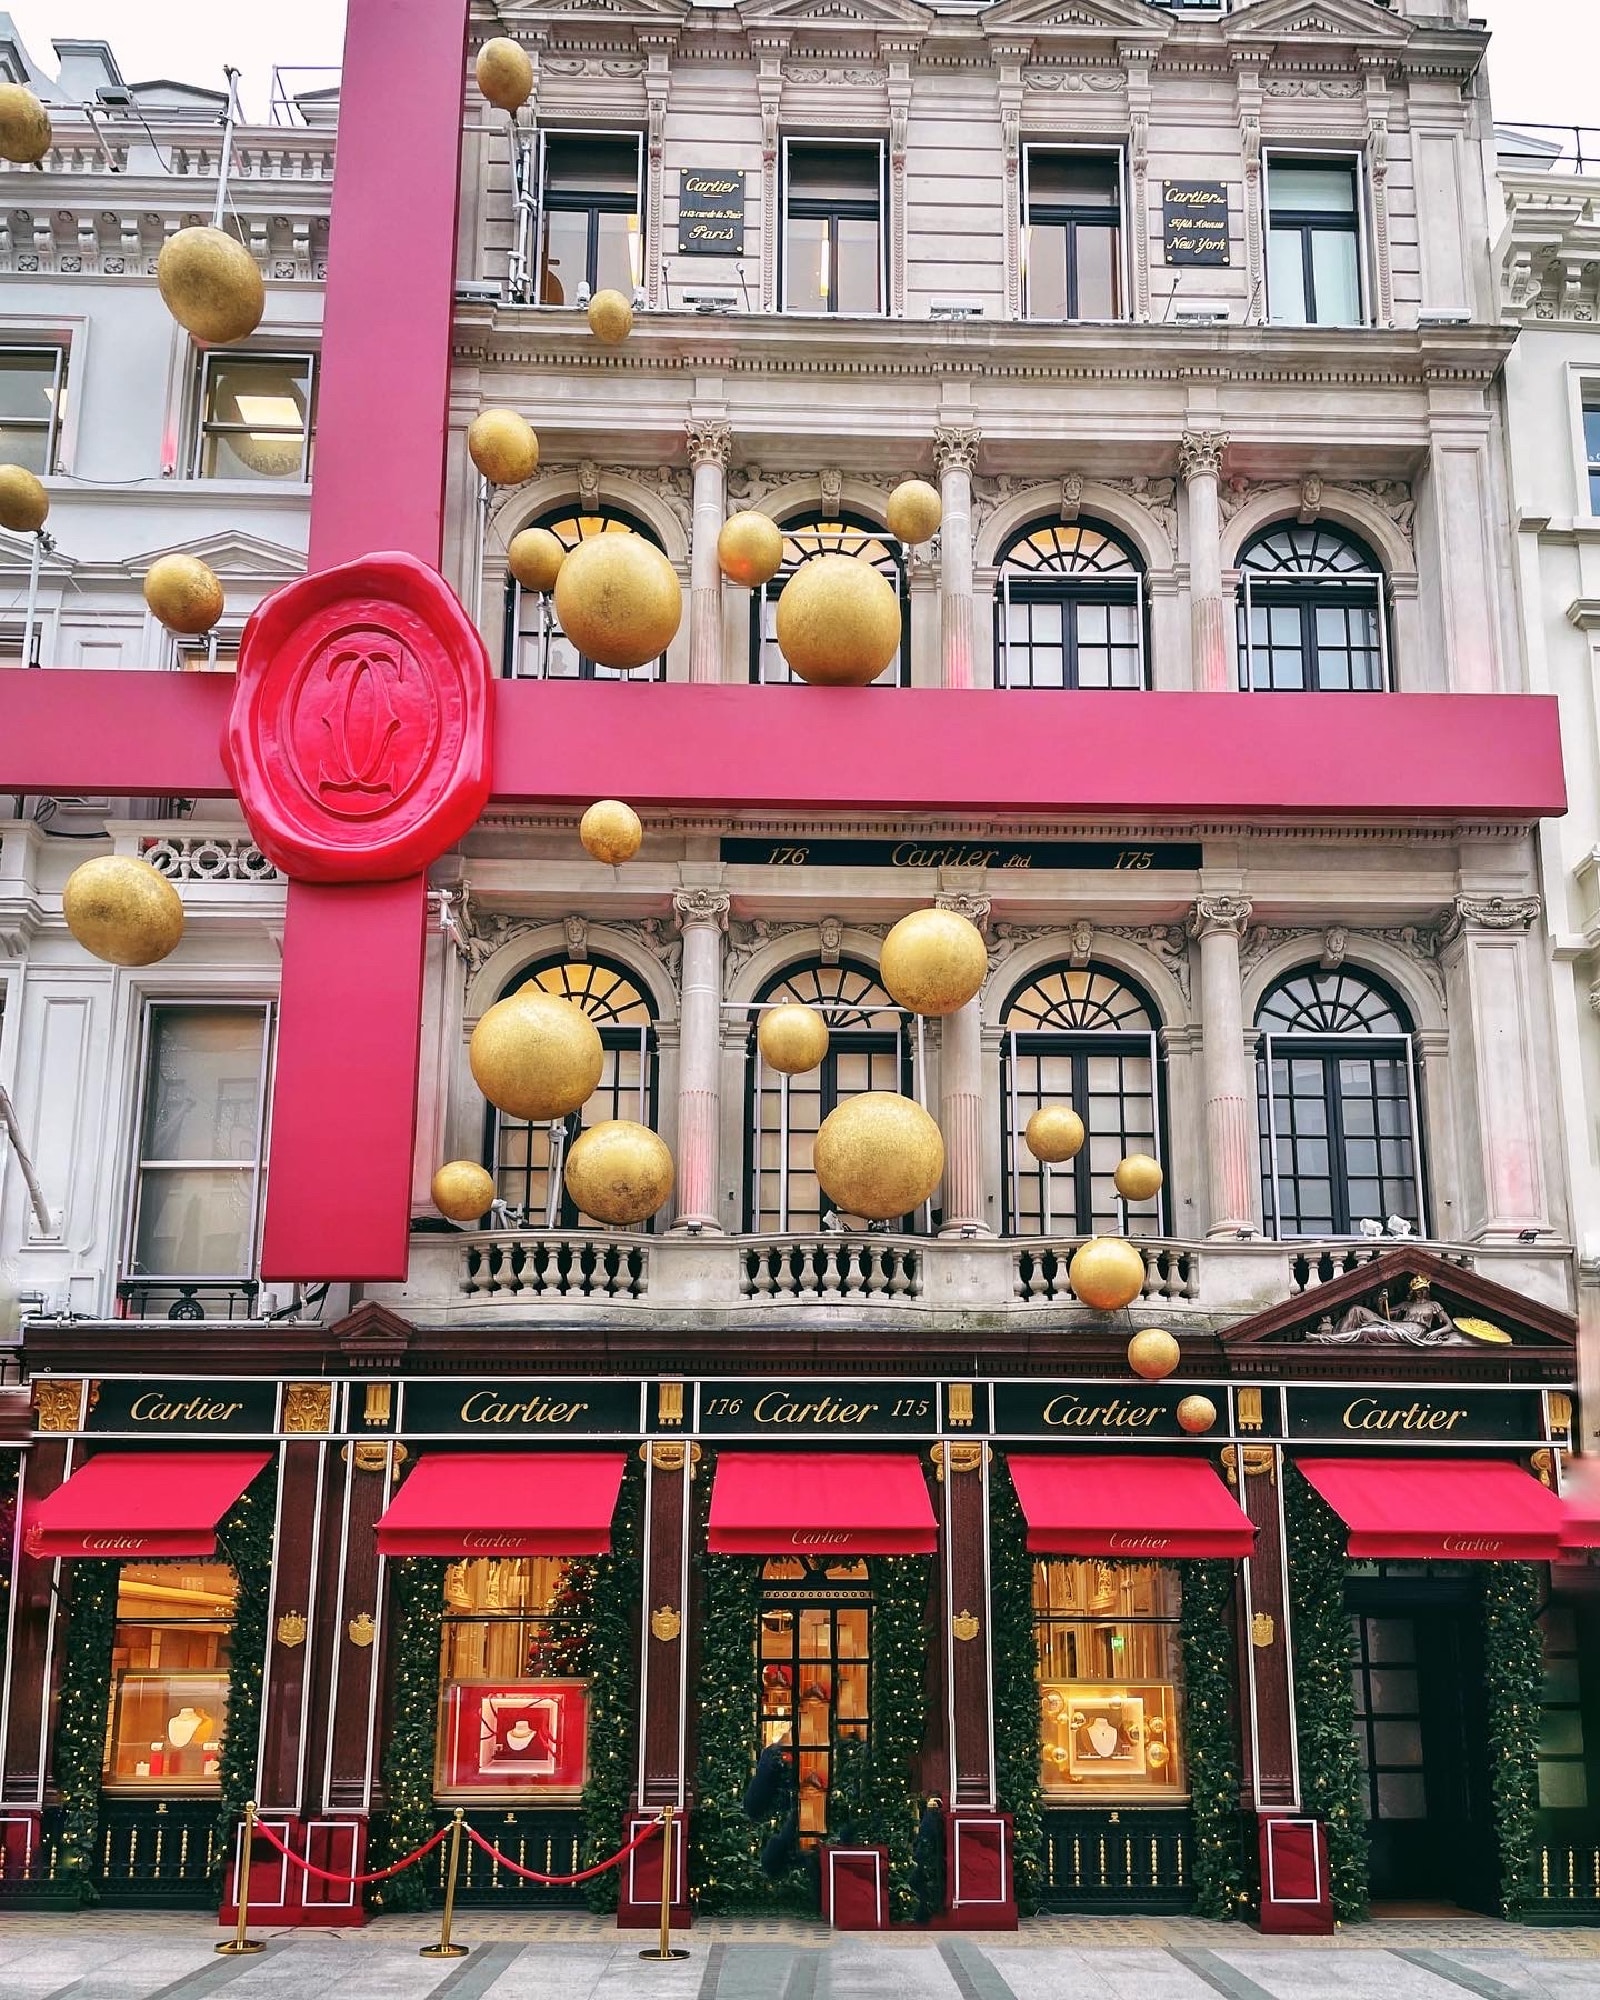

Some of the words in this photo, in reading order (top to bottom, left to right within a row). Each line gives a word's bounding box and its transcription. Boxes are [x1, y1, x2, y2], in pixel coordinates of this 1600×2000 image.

[686, 177, 739, 193] Cartier
[1165, 188, 1218, 204] Cartier
[688, 225, 734, 240] Paris
[1168, 218, 1192, 231] Fifth
[1166, 237, 1195, 250] New
[1193, 237, 1226, 254] York
[768, 847, 810, 865] 176
[891, 841, 1000, 868] Cartier
[1002, 853, 1033, 868] Ltd
[1113, 851, 1154, 870] 175
[129, 1392, 244, 1421] Cartier
[460, 1390, 589, 1424] Cartier
[704, 1398, 743, 1416] 176
[753, 1390, 879, 1424] Cartier
[891, 1399, 929, 1417] 175
[1042, 1394, 1168, 1427] Cartier
[1342, 1397, 1468, 1430] Cartier
[82, 1533, 148, 1550] Cartier
[462, 1530, 528, 1549] Cartier
[790, 1529, 853, 1546] Cartier
[1109, 1531, 1171, 1549] Cartier
[1442, 1534, 1504, 1553] Cartier
